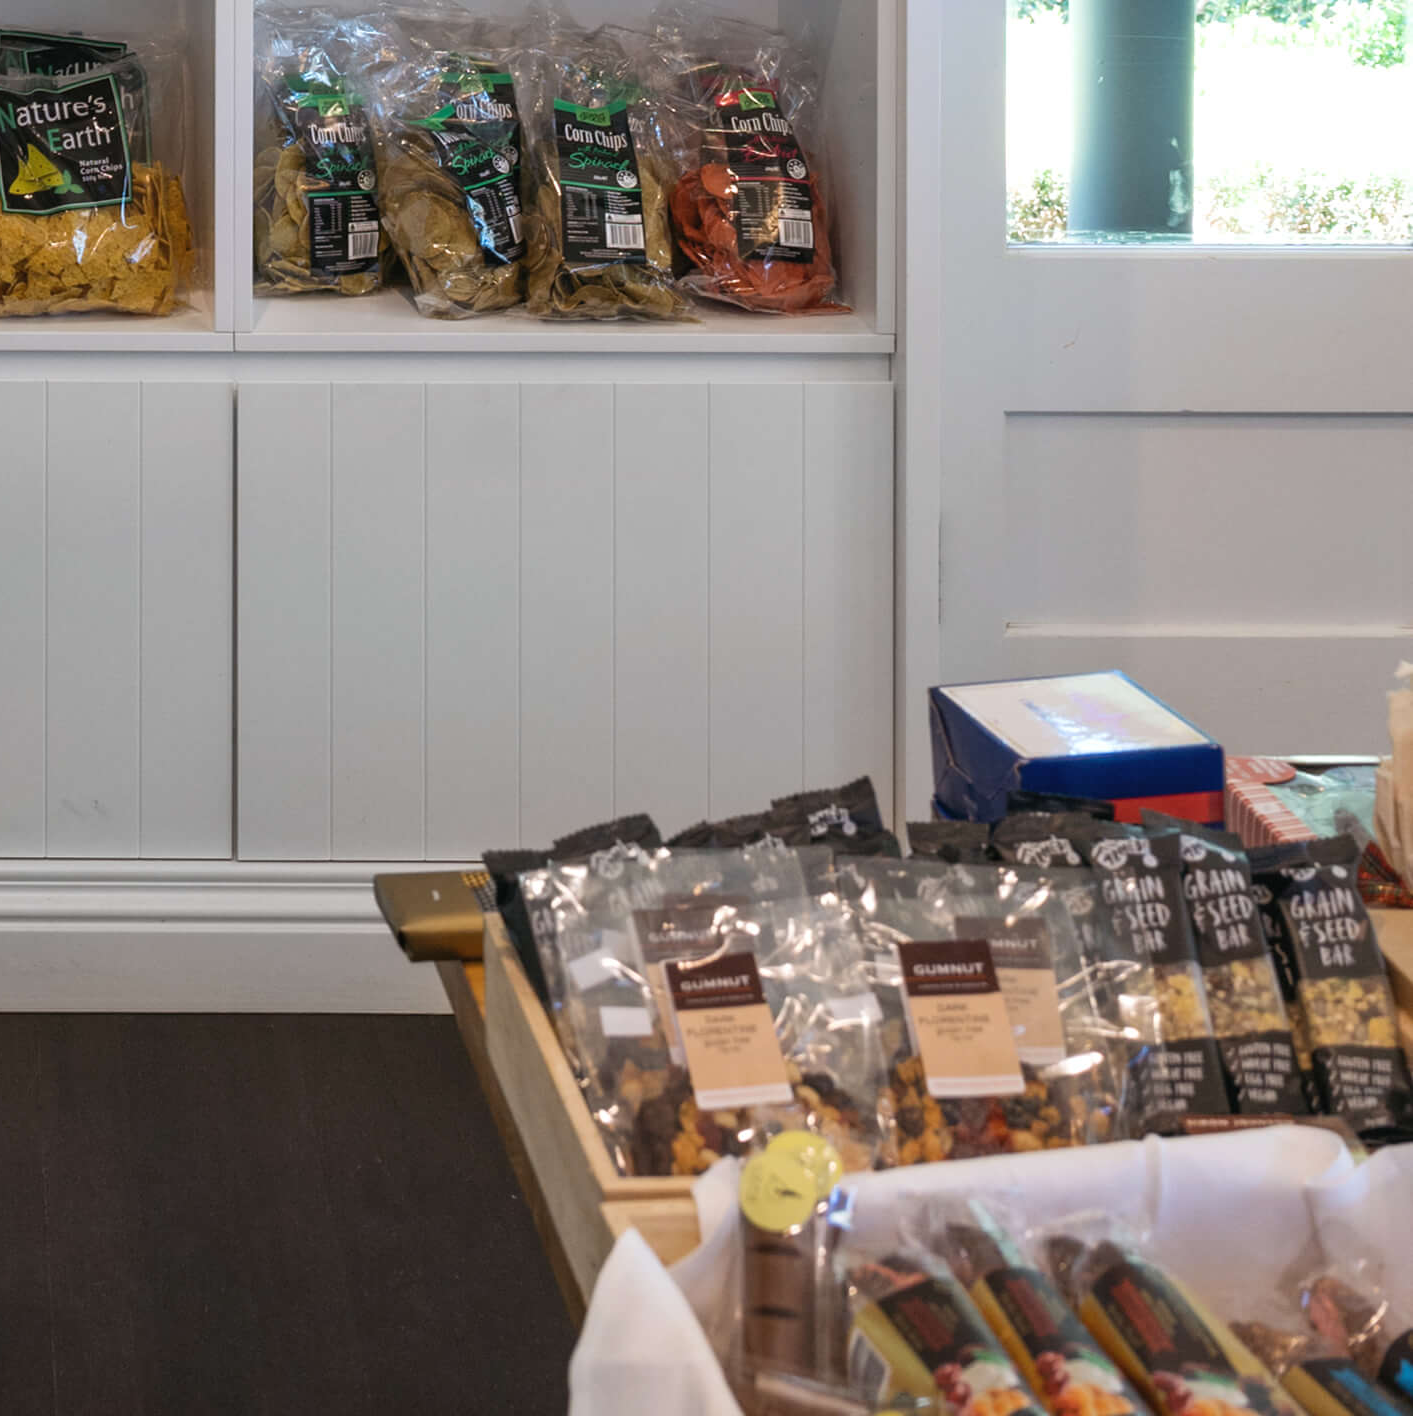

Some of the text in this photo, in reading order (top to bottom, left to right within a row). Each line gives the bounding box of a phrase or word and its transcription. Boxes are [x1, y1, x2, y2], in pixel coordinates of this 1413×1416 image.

[47, 123, 111, 152] Earth
[310, 123, 366, 145] Corn Chips
[564, 124, 628, 151] Corn Chips
[731, 116, 760, 133] Corn
[79, 157, 109, 167] Natural
[80, 164, 123, 175] Corn Chips
[1102, 876, 1164, 904] GRAIN
[1184, 868, 1246, 898] GRAIN
[1126, 903, 1171, 929] SEED
[1206, 894, 1254, 926] SEED
[1290, 888, 1355, 918] GRAIN
[1132, 930, 1168, 954] BAR
[1216, 922, 1250, 951] BAR
[1313, 917, 1362, 944] SEED
[1318, 944, 1356, 966] BAR
[913, 962, 984, 976] GUMNUT
[680, 975, 750, 992] GUMNUT
